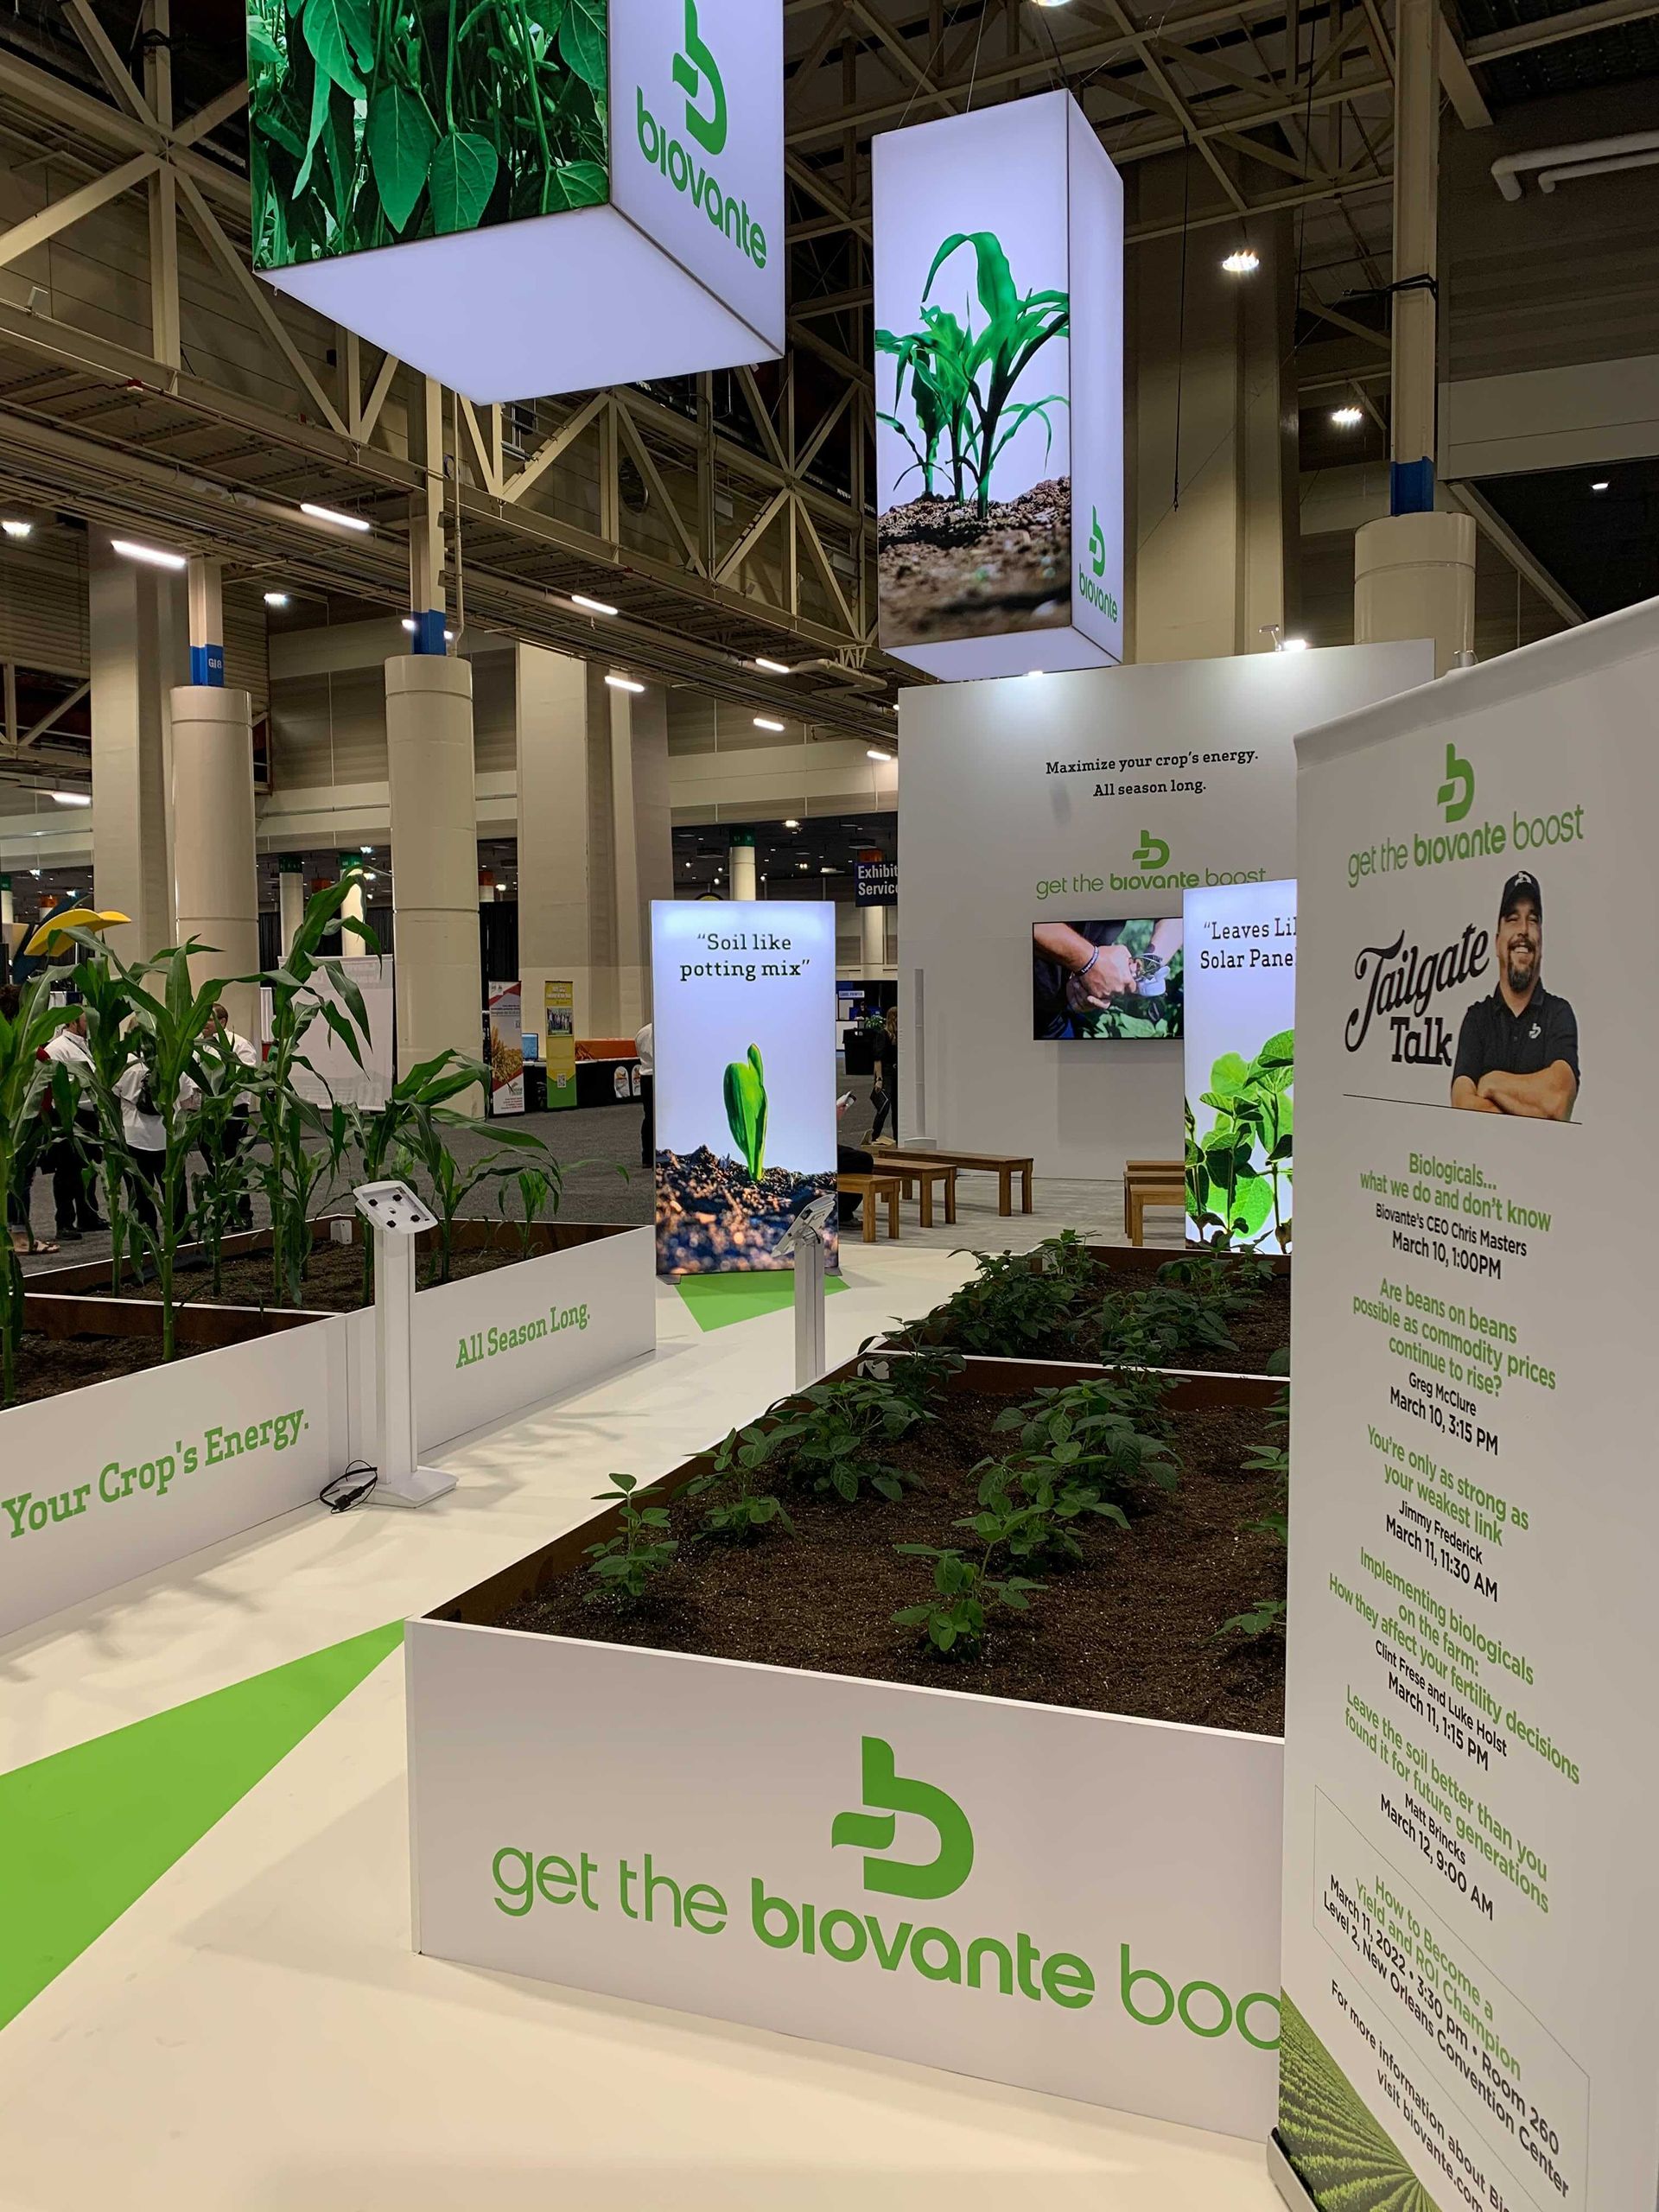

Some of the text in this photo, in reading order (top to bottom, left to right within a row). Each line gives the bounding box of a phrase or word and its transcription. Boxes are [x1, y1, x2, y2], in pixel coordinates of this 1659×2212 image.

[637, 84, 766, 269] biovante
[1079, 563, 1117, 623] biovante
[1046, 749, 1259, 774] Maximize your crop's energy.
[1093, 779, 1206, 797] All season long.
[858, 864, 899, 879] Exhibit
[1036, 876, 1067, 899] get
[1073, 874, 1103, 892] the
[1110, 871, 1199, 890] biovante
[1348, 804, 1585, 888] get the biovante boost
[680, 960, 756, 982] potting
[753, 933, 791, 950] like
[1200, 948, 1296, 969] Solar Pane
[1344, 922, 1490, 1052] Tailgate
[1390, 1016, 1452, 1066] Talk
[1360, 1170, 1552, 1232] what we do and don't know
[1408, 1152, 1497, 1190] Biologicals...
[1376, 1203, 1527, 1256] Biovante's CEO Chris Masters
[1392, 1230, 1501, 1280] March 10, 1:00PM
[455, 1304, 590, 1369] All Season Long.
[1353, 1295, 1556, 1390] possible as commodity prices
[1380, 1278, 1517, 1344] Are beans on beans
[1389, 1337, 1503, 1397] continue to rise?
[1408, 1372, 1477, 1416] Greg McClure
[1390, 1386, 1498, 1456] March 10, 3:15 PM
[1, 1409, 309, 1539] Your Crop's Energy.
[1367, 1424, 1529, 1530] You're only as strong as
[1384, 1463, 1503, 1547] your weakest link
[1386, 1514, 1497, 1603] March 11, 11:30 AM
[1399, 1500, 1483, 1565] Jimmy Frederick
[1360, 1547, 1534, 1686] Implementing biologicals
[1399, 1604, 1479, 1677] on the farm:
[1330, 1573, 1580, 1785] How they affect your fertility decisions
[1376, 1639, 1507, 1758] Clint Frese and Luke Holst
[1389, 1671, 1488, 1771] March 11, 1:15 PM
[1345, 1707, 1549, 1914] found it for future generations
[1347, 1685, 1548, 1882] Leave the soil better than you
[1381, 1793, 1493, 1922] March 12, 9:00 AM
[1405, 1793, 1465, 1866] Matt Brincks
[492, 1847, 599, 1917] get
[620, 1853, 728, 1935] the
[751, 1877, 1096, 2010] biovante
[1376, 1875, 1493, 2022] How to Become a
[1331, 1874, 1559, 2156] March 11, 2022 3:30 pm Room 260
[1356, 1877, 1521, 2082] Yield and ROI Champion
[1324, 1891, 1569, 2198] Level 2, New Orleans Convention Center
[1332, 1979, 1348, 2011] For
[1350, 2006, 1376, 2050] more
[1379, 2040, 1445, 2140] information
[1448, 2136, 1485, 2194] about
[1377, 2069, 1483, 2212] visit biovante.com
